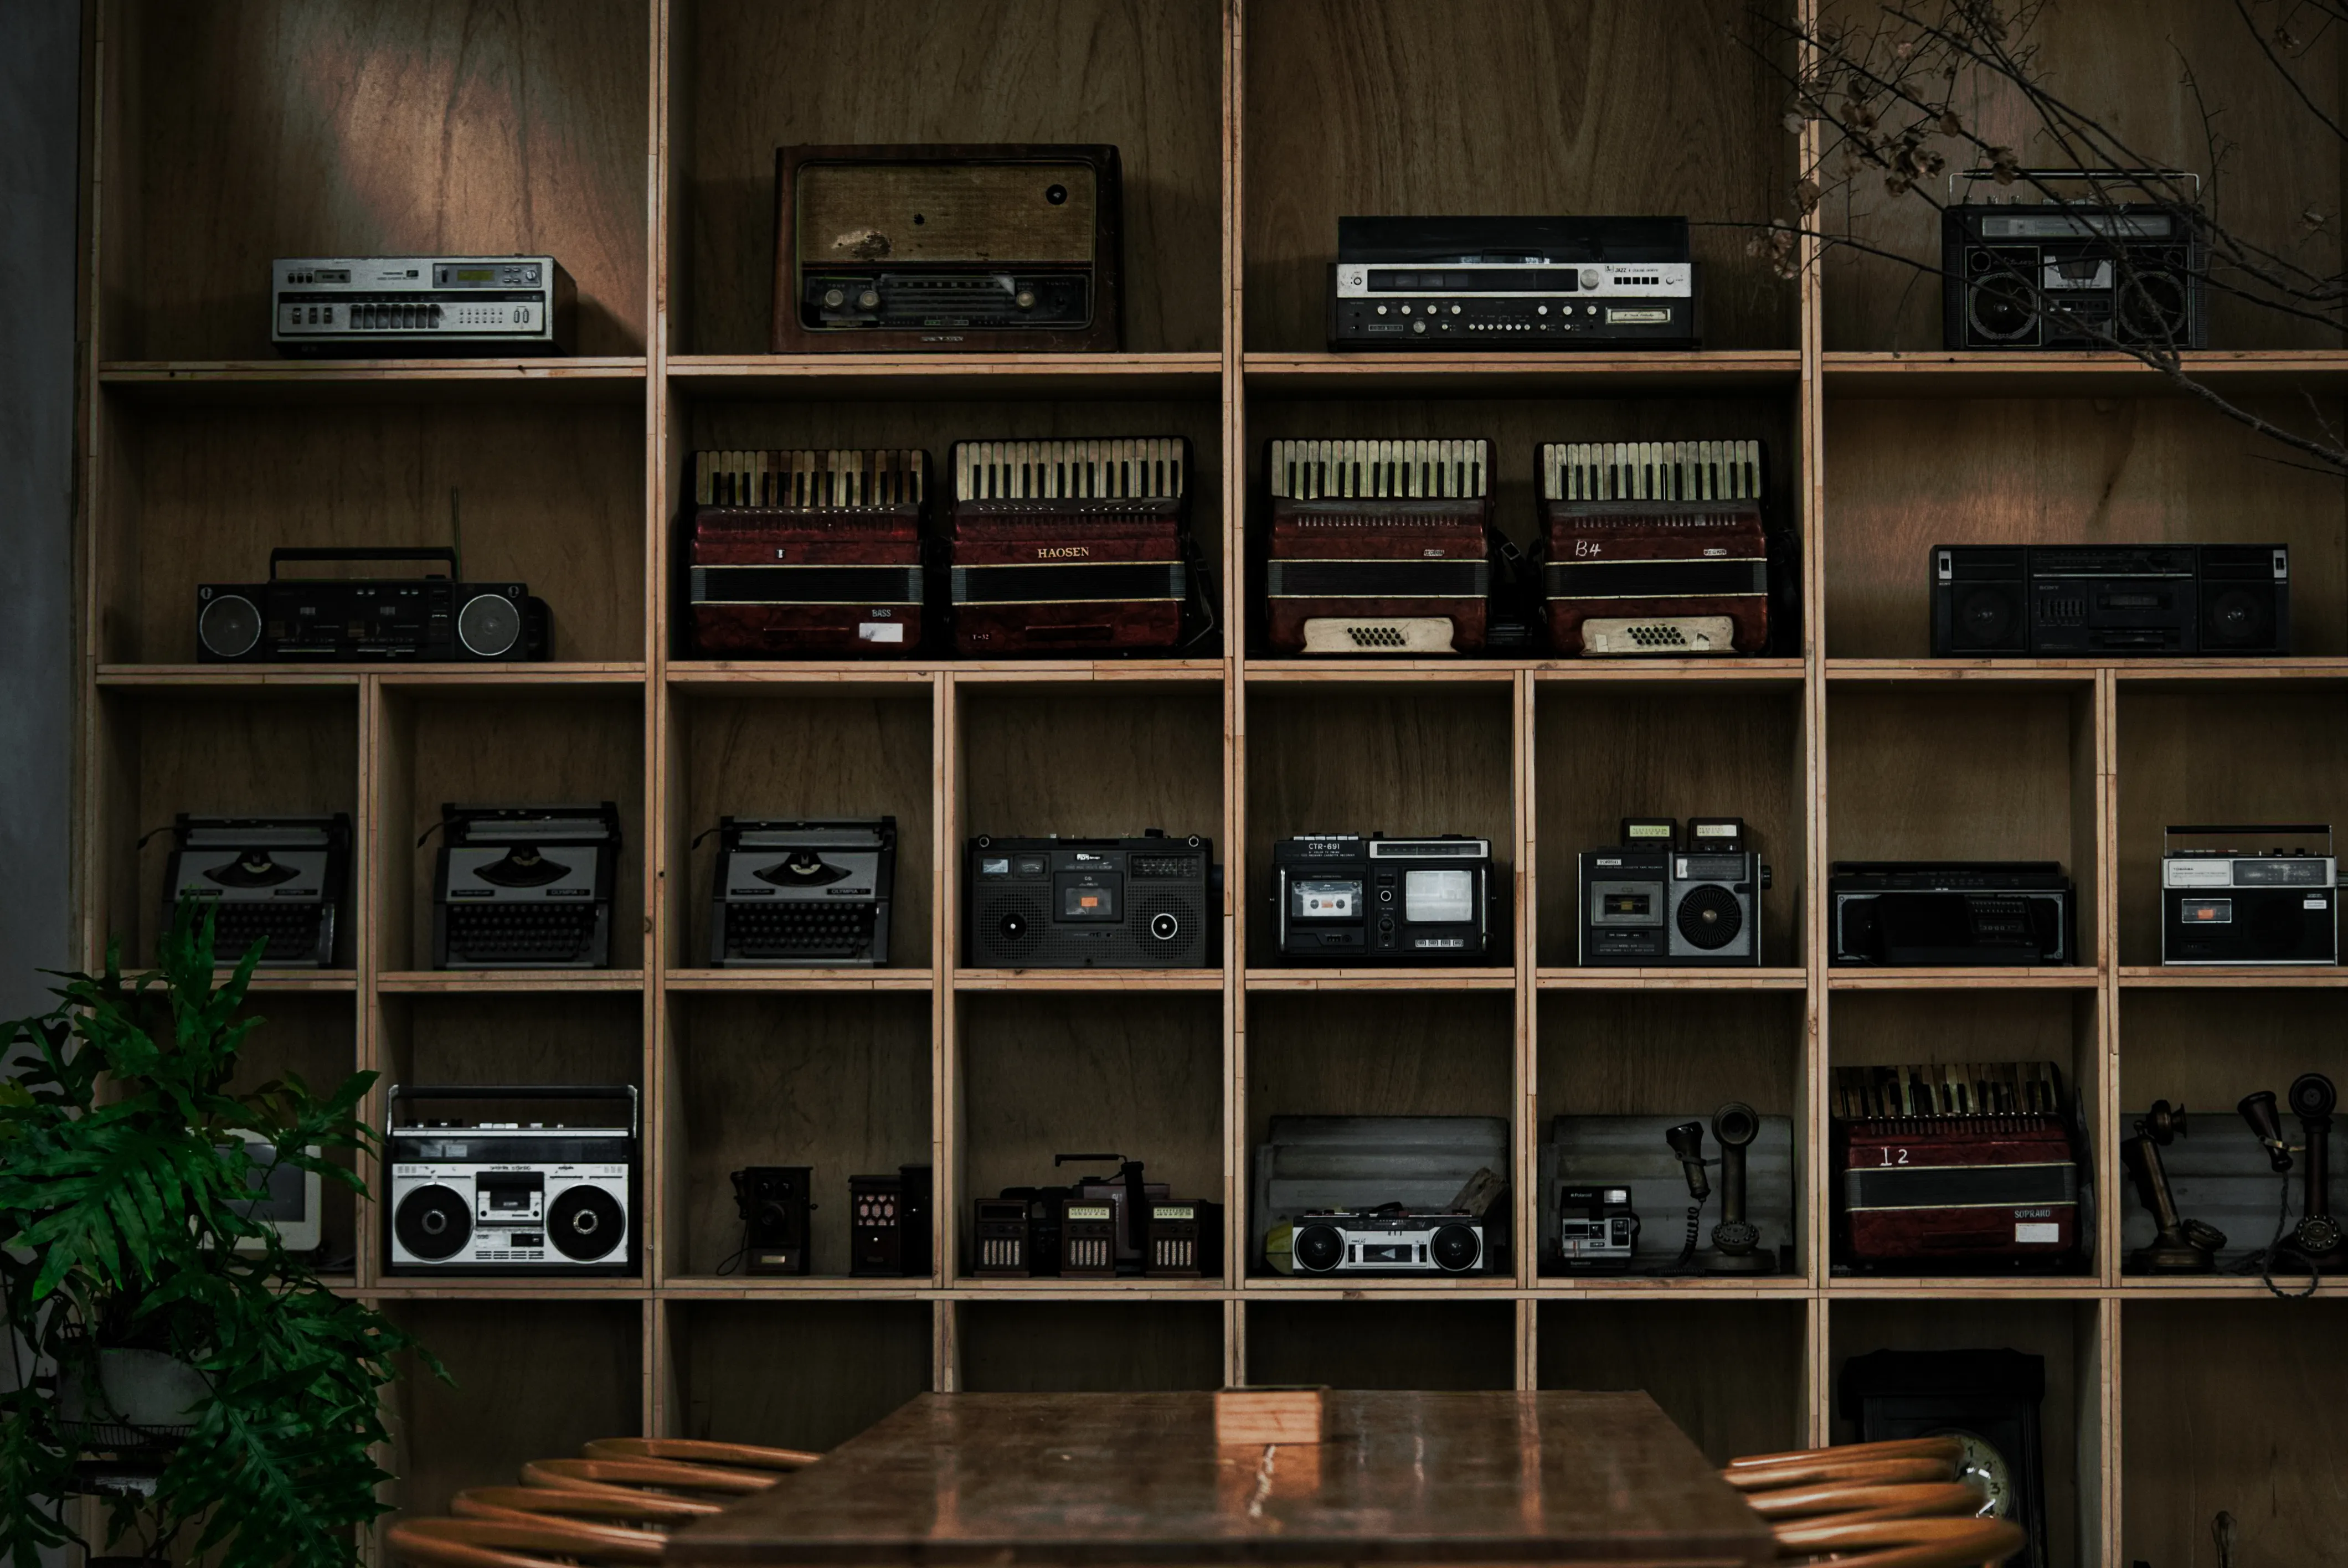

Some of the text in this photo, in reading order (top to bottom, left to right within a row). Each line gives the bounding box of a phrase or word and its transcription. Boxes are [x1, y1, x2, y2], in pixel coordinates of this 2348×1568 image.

[1037, 546, 1090, 558] HAOSEN
[1575, 539, 1602, 557] B4
[872, 609, 892, 617] BASS
[2014, 1209, 2051, 1218] SOPRANO
[1968, 1446, 1973, 1457] 1
[1984, 1461, 1992, 1474] 2
[1990, 1483, 2000, 1495] 3
